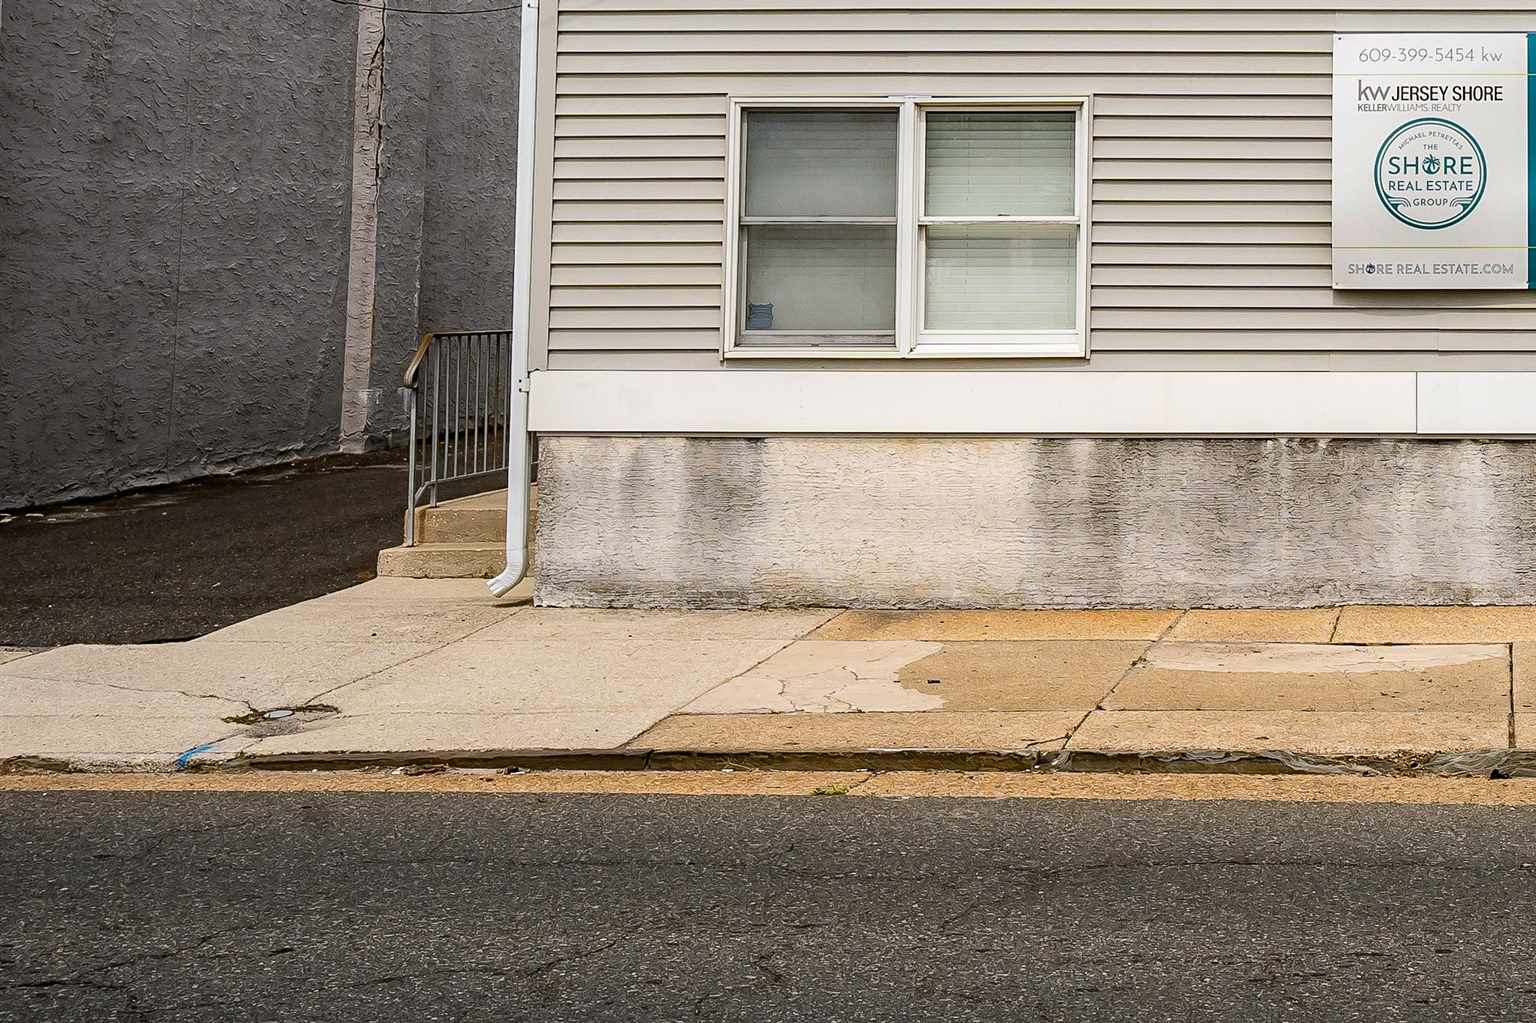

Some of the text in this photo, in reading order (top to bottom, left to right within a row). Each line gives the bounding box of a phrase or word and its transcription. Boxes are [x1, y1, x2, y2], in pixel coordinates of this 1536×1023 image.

[1359, 46, 1504, 63] 609-399-5454 kw
[1358, 79, 1504, 102] kw JERSEY SHORE
[1431, 103, 1462, 113] REALTY
[1423, 143, 1439, 151] THE
[1388, 154, 1473, 175] SHORE
[1388, 180, 1474, 192] REAL ESTATE
[1413, 198, 1449, 207] GROUP
[1396, 263, 1431, 275] REAL
[1432, 263, 1514, 275] ESTATE.COM
